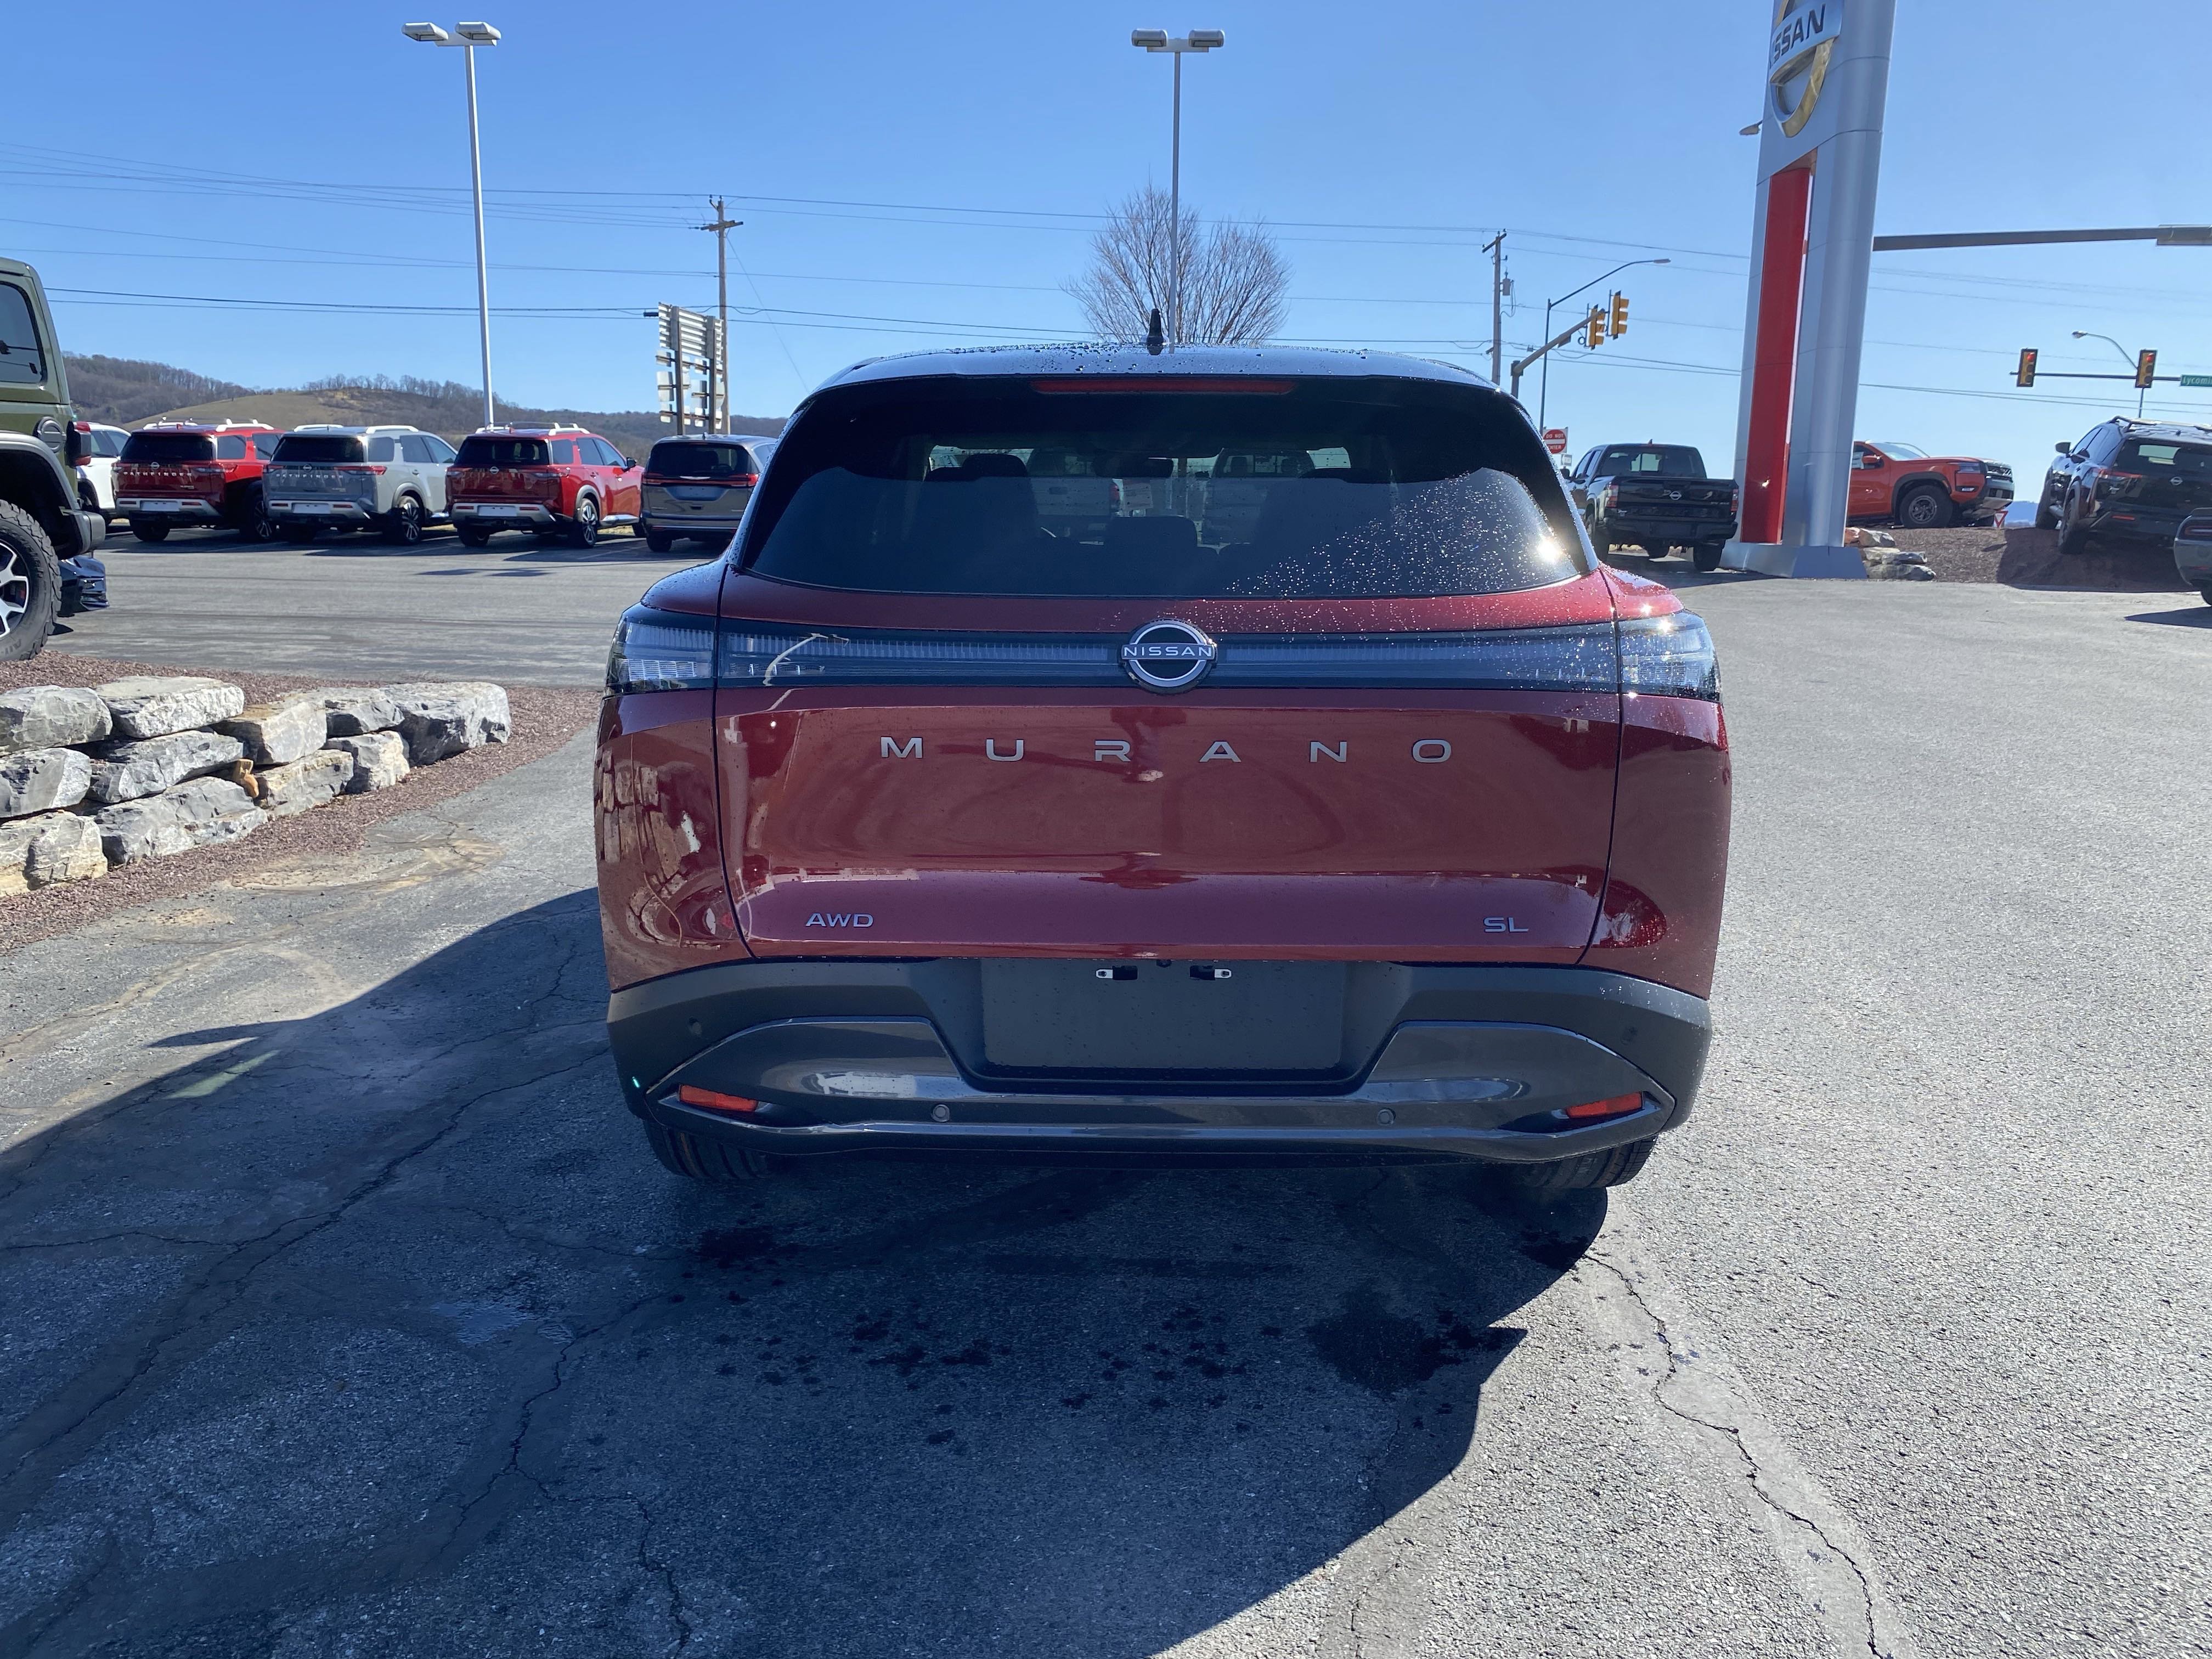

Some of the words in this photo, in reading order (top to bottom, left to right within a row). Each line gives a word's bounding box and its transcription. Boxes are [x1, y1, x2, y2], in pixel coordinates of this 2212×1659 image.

[2183, 376, 2212, 386] Lycomi
[1125, 646, 1211, 657] NISSAN
[881, 737, 1452, 763] MURANO
[806, 913, 873, 927] AWD
[1483, 917, 1529, 932] SL
